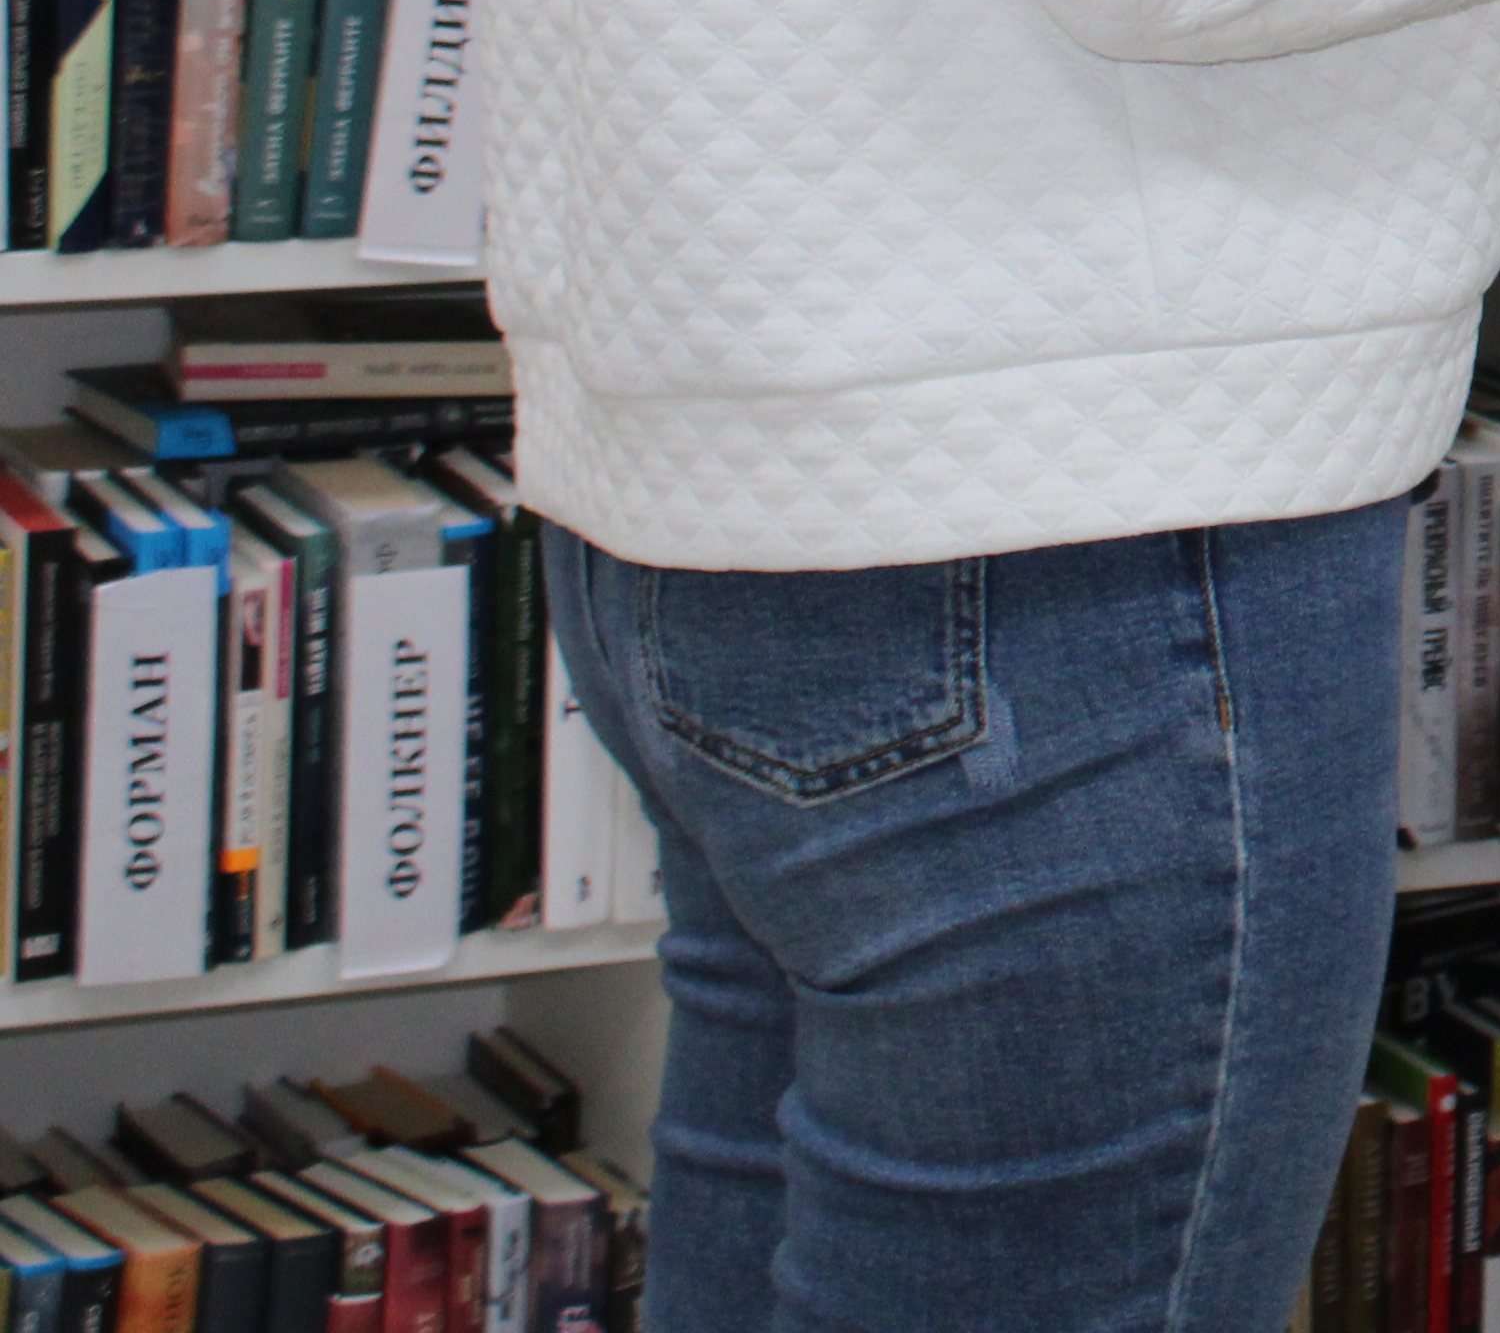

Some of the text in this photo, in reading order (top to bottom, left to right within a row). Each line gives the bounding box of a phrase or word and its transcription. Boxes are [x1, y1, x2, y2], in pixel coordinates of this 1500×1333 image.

[261, 17, 295, 185] ЭЛЕНА ФЕРРАНТЕ
[328, 15, 363, 182] ЭЛЕНА ФЕРРАНТЕ
[120, 651, 172, 892] ФОРМАН
[383, 637, 432, 901] ФОЛКНЕР
[1461, 1112, 1486, 1254] ОБЫКНОВЕННАЯ
